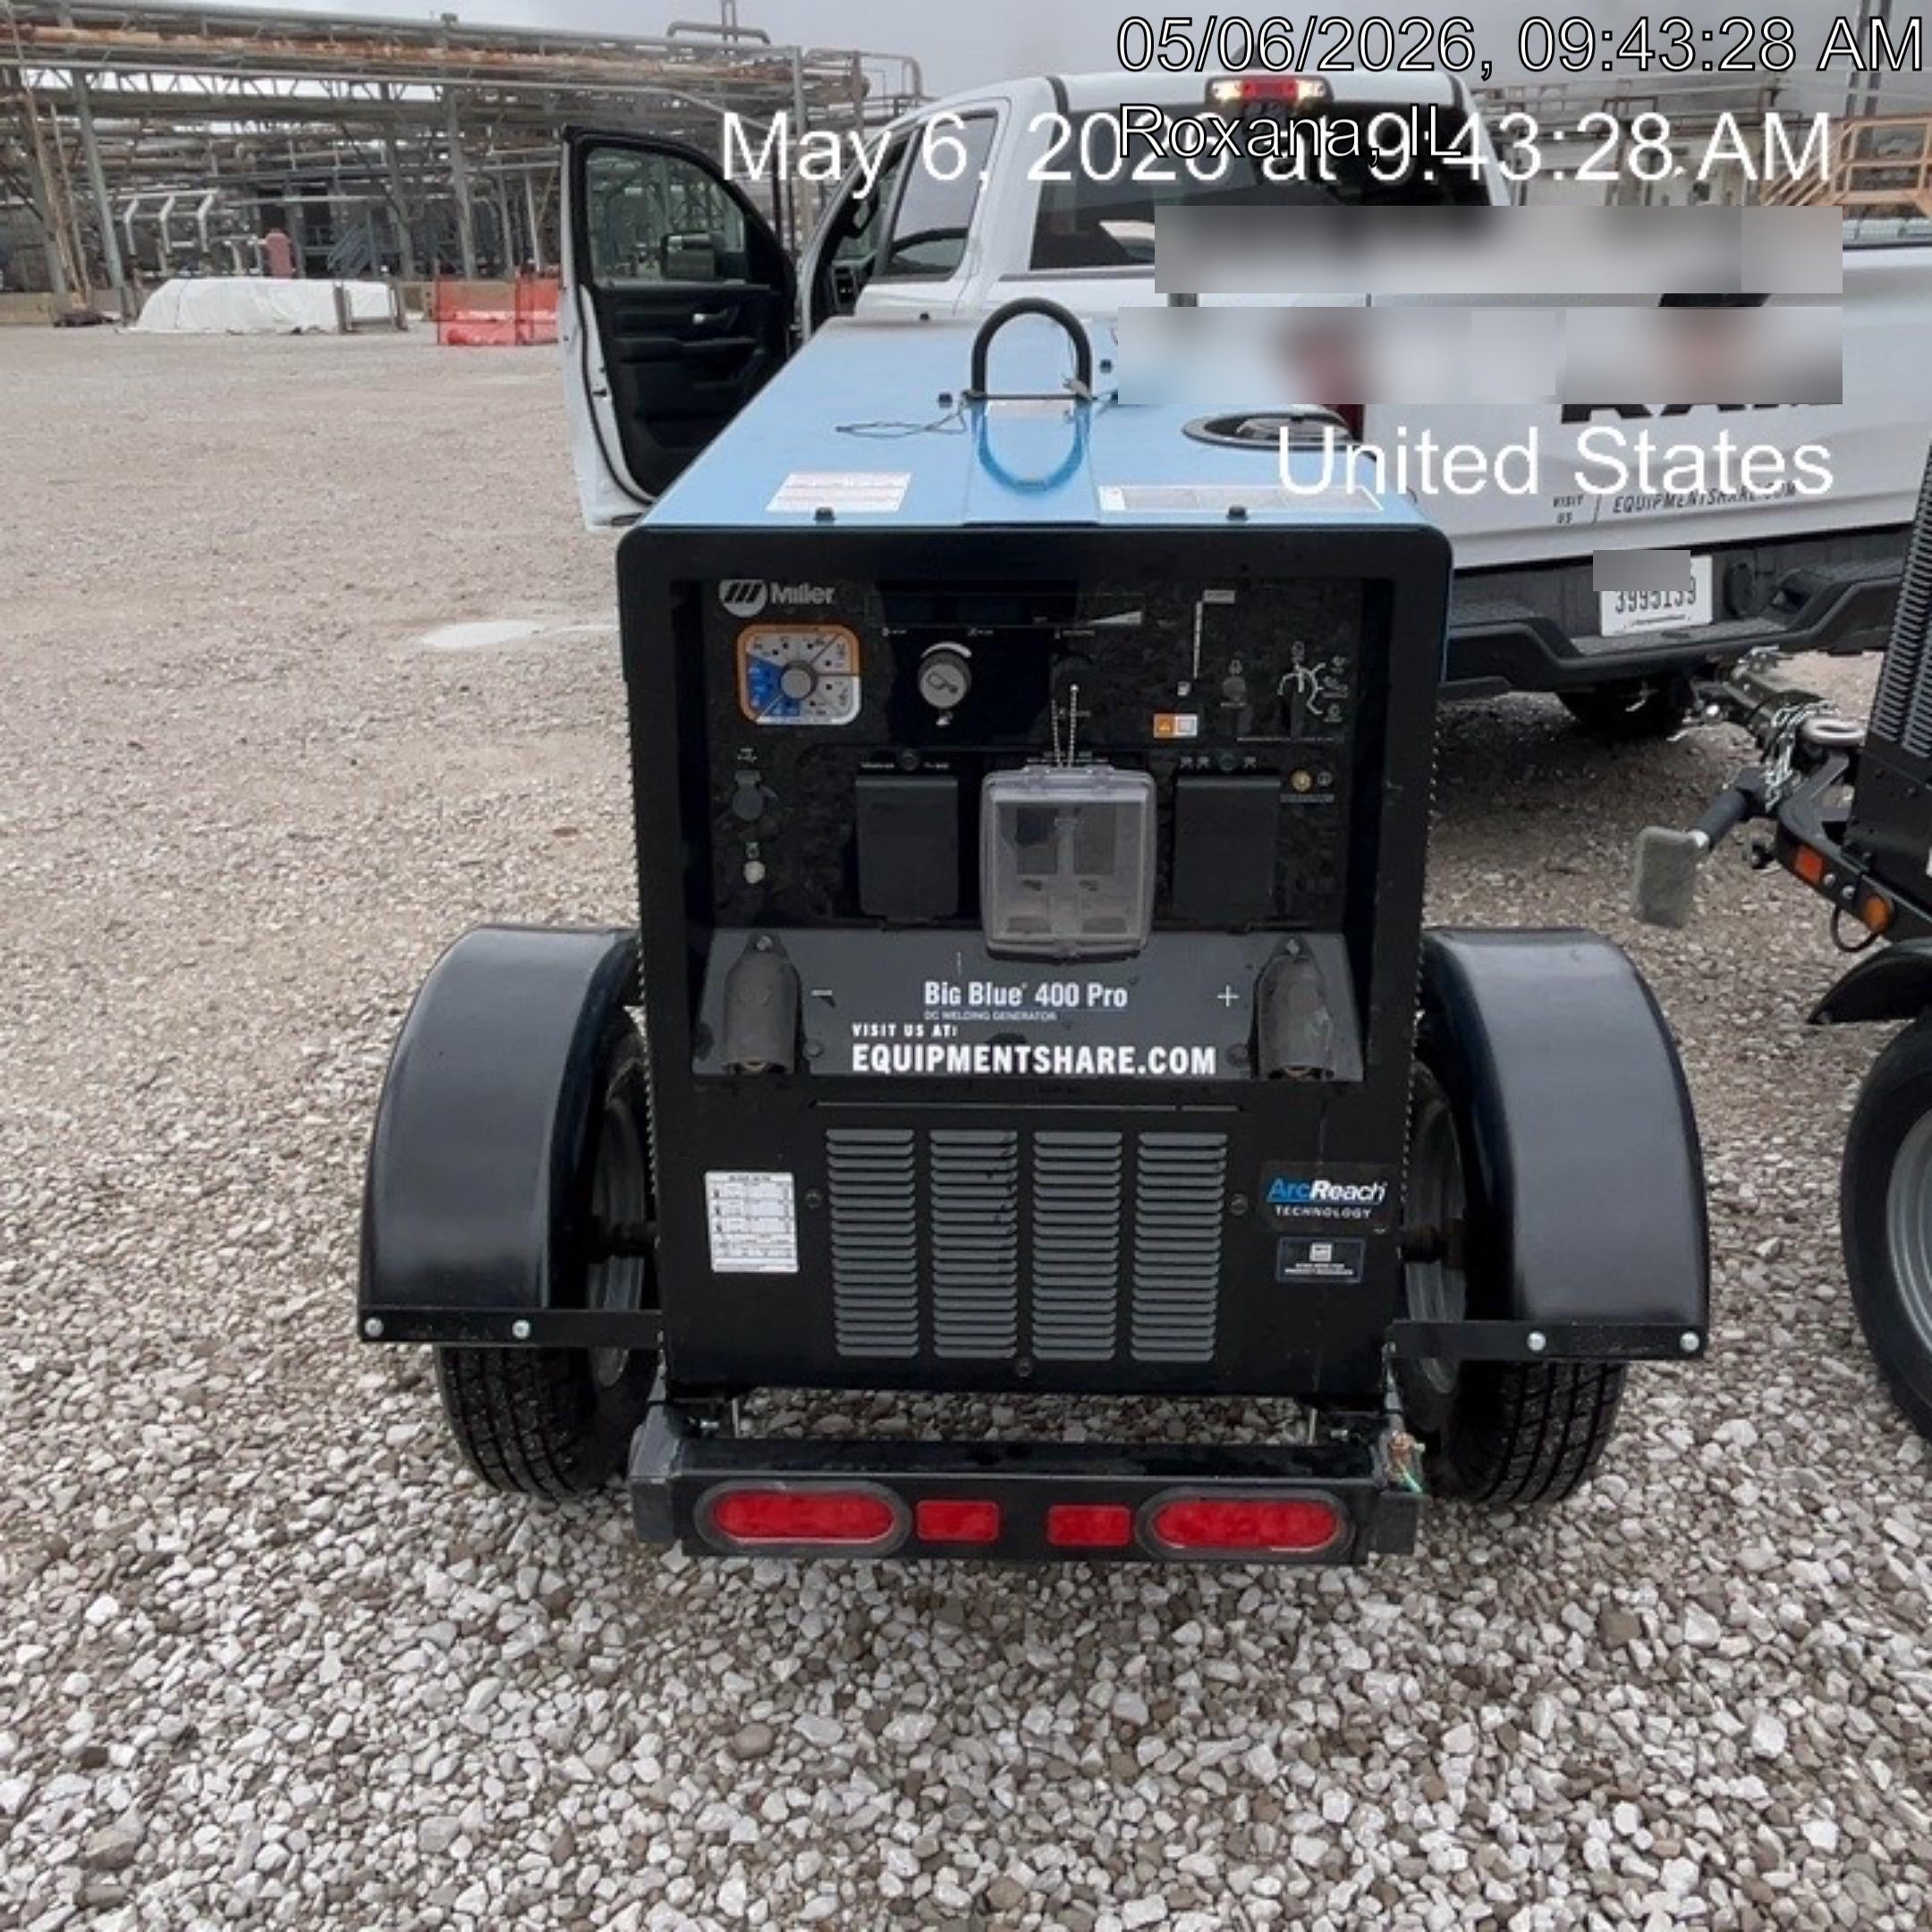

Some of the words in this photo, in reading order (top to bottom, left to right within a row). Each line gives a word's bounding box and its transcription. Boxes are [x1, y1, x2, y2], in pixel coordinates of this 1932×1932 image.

[770, 580, 835, 605] Miller
[925, 980, 962, 1006] Big
[968, 981, 1023, 1007] Blue
[1034, 982, 1080, 1007] 400
[1087, 982, 1129, 1008] Pro
[941, 1010, 990, 1021] WELDING
[992, 1010, 1057, 1022] GENERATOR
[852, 1023, 896, 1038] VISIT
[903, 1023, 924, 1038] US
[931, 1023, 958, 1038] AT:
[852, 1043, 1216, 1075] EQUIPMENTSHARE.COM
[1267, 1177, 1387, 1202] ArcReach
[1275, 1204, 1372, 1219] TECHNOLOGY
